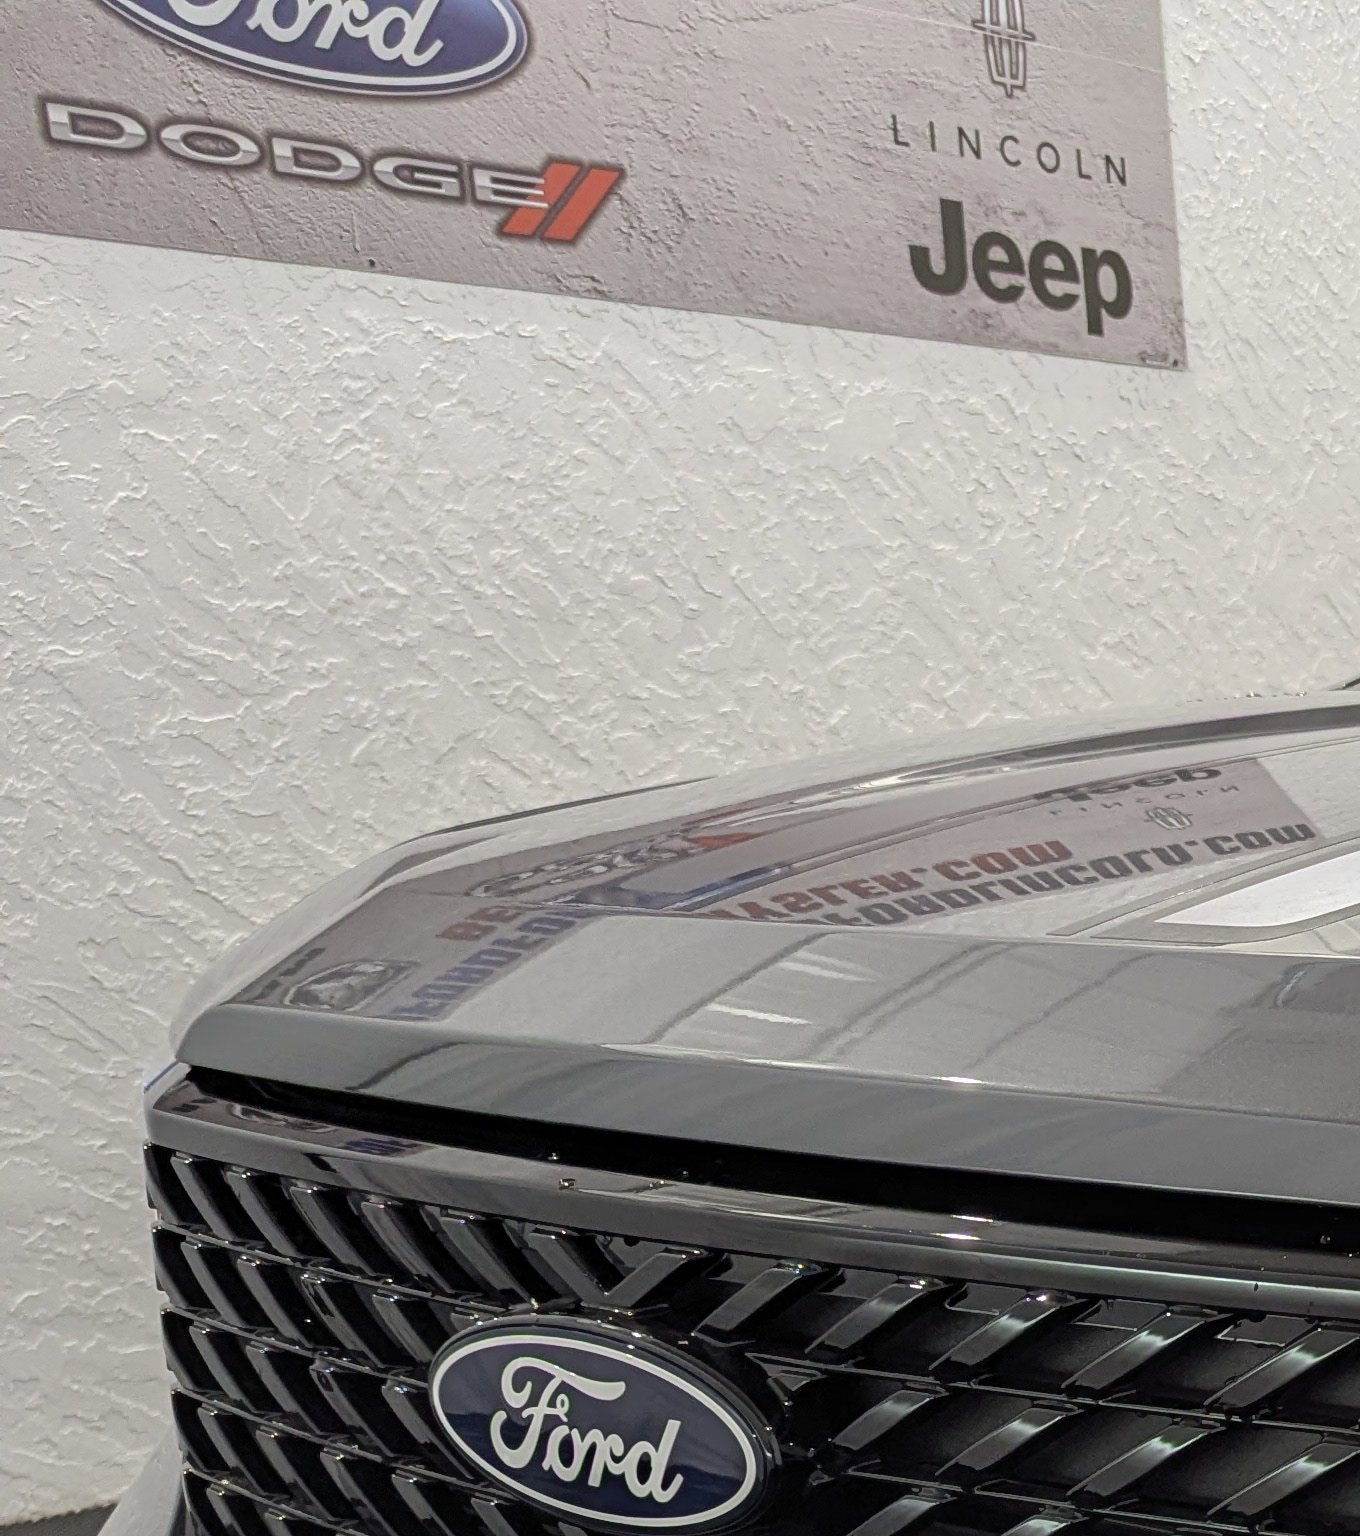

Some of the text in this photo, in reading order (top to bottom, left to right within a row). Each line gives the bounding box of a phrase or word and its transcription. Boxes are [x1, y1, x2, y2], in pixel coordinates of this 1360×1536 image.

[45, 102, 549, 209] DODGE
[890, 113, 1128, 187] LINCOLN
[908, 198, 1133, 337] Jeep
[490, 1356, 684, 1503] Ford
